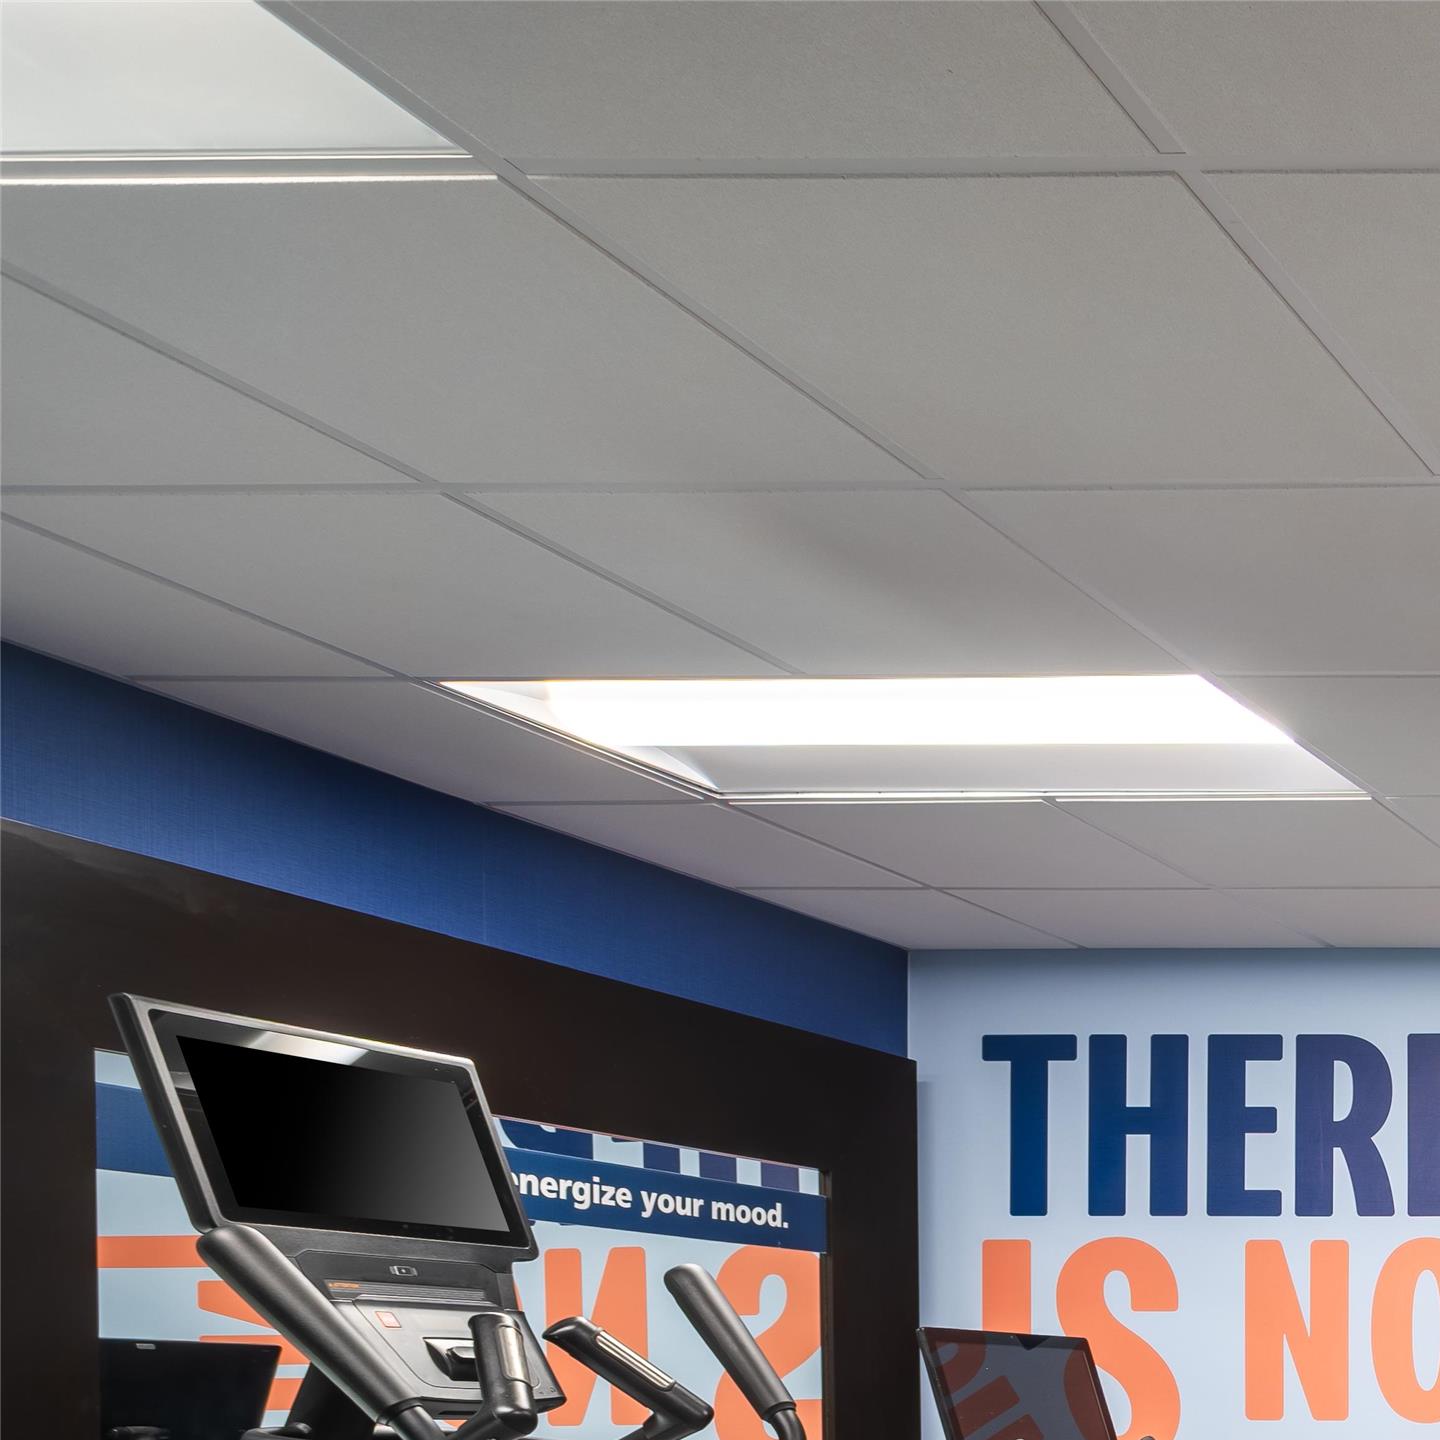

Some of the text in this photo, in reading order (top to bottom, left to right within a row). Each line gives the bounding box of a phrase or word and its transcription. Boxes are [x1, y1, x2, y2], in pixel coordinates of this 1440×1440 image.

[511, 1171, 790, 1229] nergize your mood.
